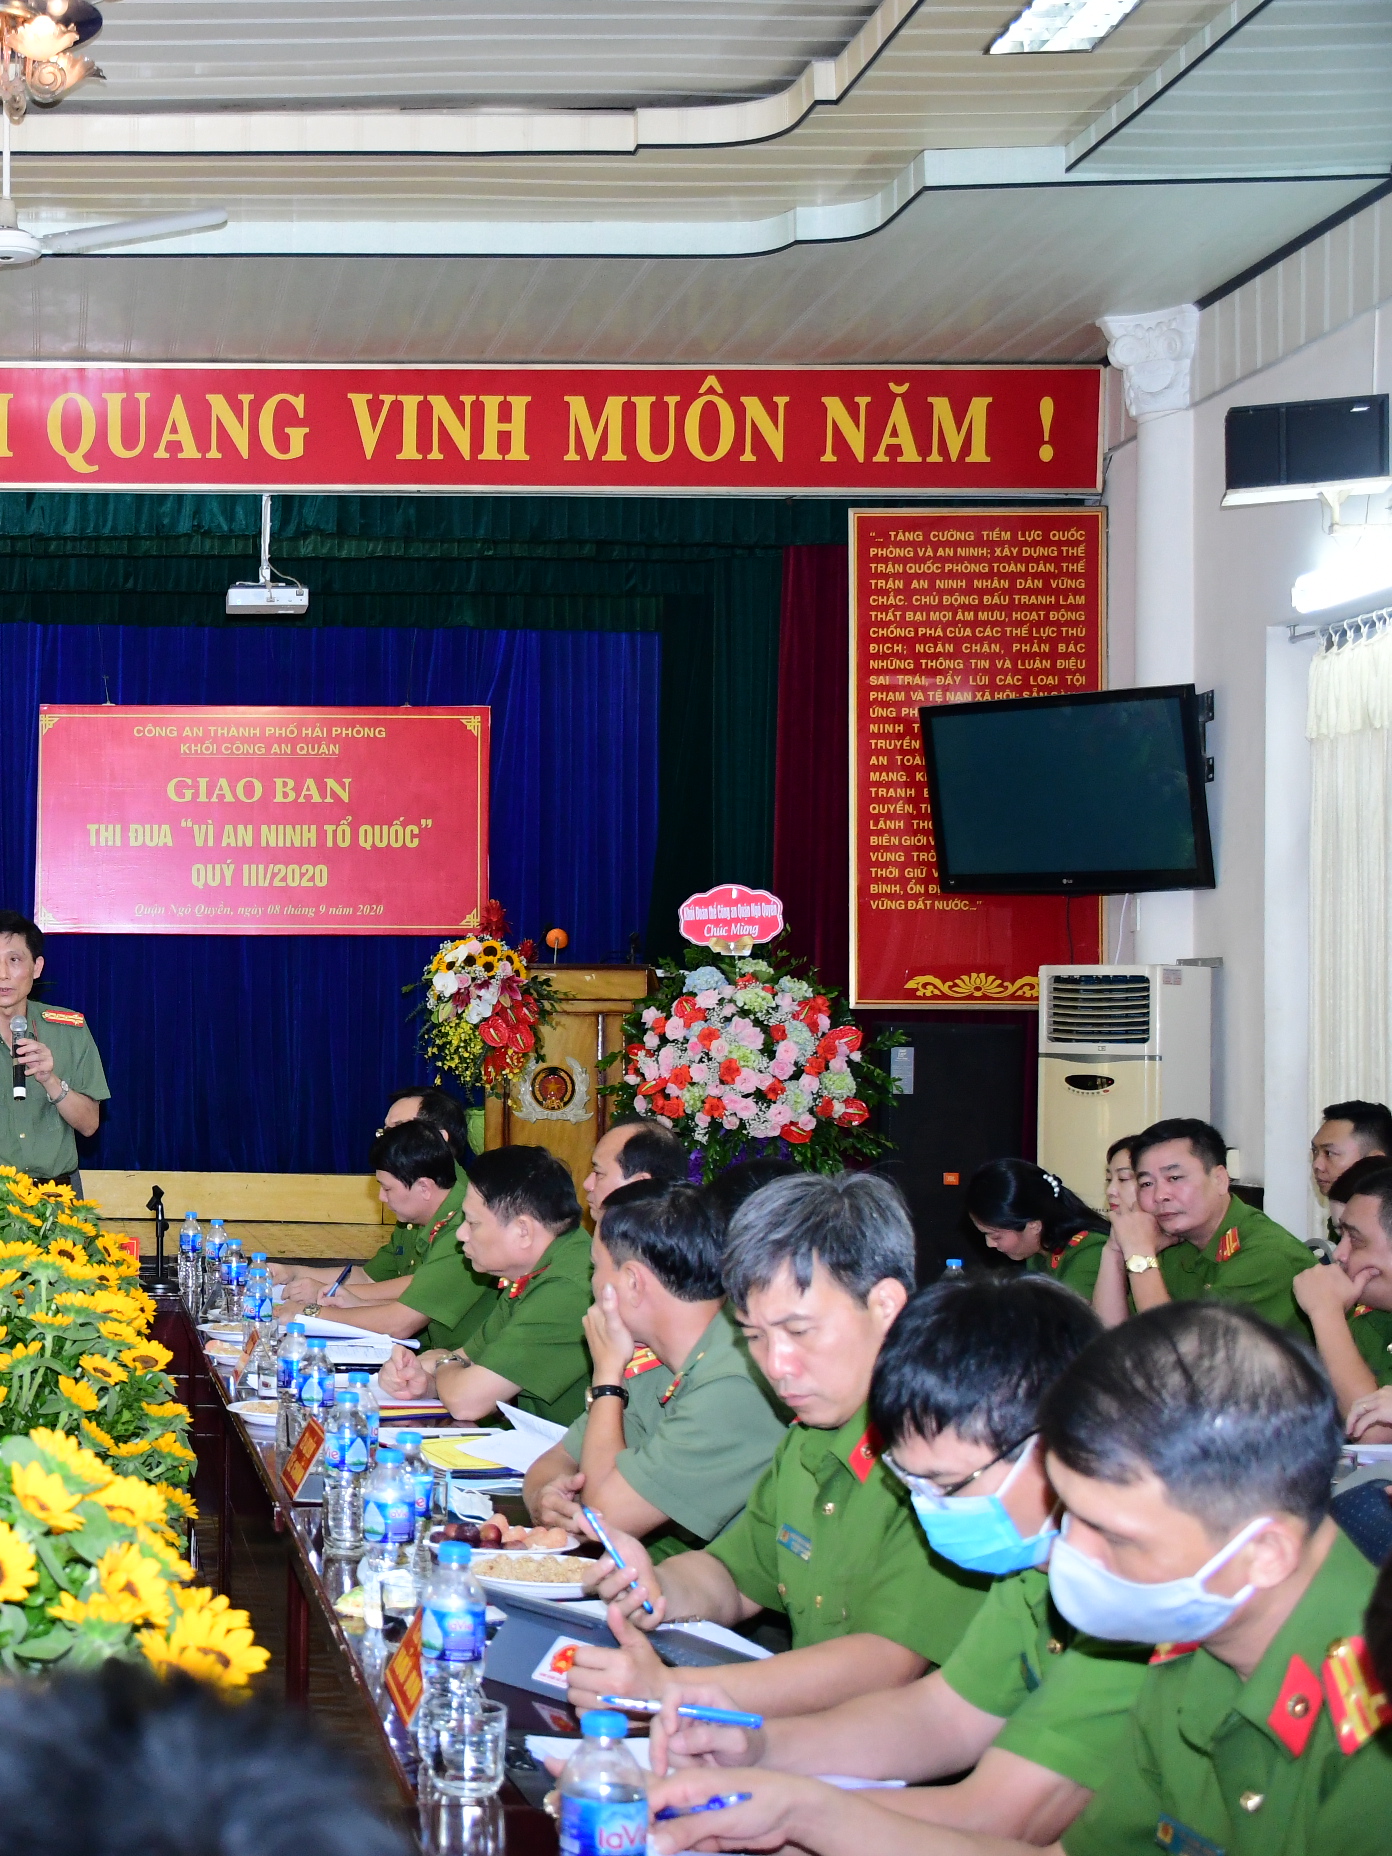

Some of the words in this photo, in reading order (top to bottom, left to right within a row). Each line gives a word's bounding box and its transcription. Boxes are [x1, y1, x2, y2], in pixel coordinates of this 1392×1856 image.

[46, 392, 309, 473] QUANG
[348, 393, 531, 461] VINH
[564, 375, 789, 462] MUÔN
[820, 383, 992, 462] NĂM
[889, 530, 923, 541] TĂNG
[930, 529, 975, 541] CƯỜNG
[1018, 531, 1042, 543] LỰC
[1049, 527, 1086, 542] QUỐC
[870, 545, 913, 558] PHÒNG
[917, 545, 933, 557] VÀ
[937, 547, 953, 557] AN
[957, 547, 991, 558] NINH;
[994, 545, 1018, 557] XÂY
[1022, 547, 1057, 559] DỰNG
[1061, 543, 1086, 557] THẾ
[870, 562, 903, 574] TRẬN
[906, 560, 941, 574] QUỐC
[945, 562, 988, 573] PHÒNG
[992, 561, 1026, 573] TOÀN
[1061, 560, 1086, 573] THẾ
[870, 578, 903, 591] TRẬN
[911, 580, 928, 589] AN
[936, 580, 965, 589] NINH
[974, 578, 1009, 589] NHÂN
[1016, 578, 1042, 589] DÂN
[1050, 578, 1085, 589] VỮNG
[913, 592, 939, 605] CHỦ
[942, 593, 978, 607] ĐỘNG
[983, 591, 1009, 605] ĐẤU
[1013, 596, 1055, 605] TRANH
[1060, 593, 1085, 605] LÀM
[870, 608, 902, 622] THẤT
[906, 612, 926, 623] BẠI
[930, 612, 952, 623] MỌI
[956, 609, 975, 621] ÂM
[1012, 612, 1046, 623] HOẠT
[1049, 609, 1085, 623] ĐỘNG
[870, 624, 915, 638] CHỐNG
[918, 626, 942, 637] PHÁ
[947, 624, 972, 637] CỦA
[976, 626, 1001, 637] CÁC
[1006, 624, 1029, 637] THẾ
[1033, 626, 1057, 639] LỰC
[1061, 626, 1086, 637] THÙ
[915, 642, 953, 653] NGĂN
[1058, 642, 1086, 653] BÁC
[870, 657, 914, 670] NHỮNG
[920, 658, 964, 669] THÔNG
[970, 660, 989, 669] TIN
[996, 657, 1012, 669] VÀ
[1018, 658, 1050, 671] LUẬN
[1056, 658, 1086, 671] ĐIỆU
[870, 676, 890, 686] SAI
[897, 674, 929, 687] TRÁI,
[970, 674, 989, 685] LÙI
[996, 674, 1022, 686] CÁC
[1030, 675, 1058, 687] LOẠI
[1065, 674, 1086, 687] TỘI
[870, 691, 905, 703] PHẠM
[911, 690, 924, 701] VÀ
[928, 690, 942, 703] TỆ
[975, 690, 991, 701] XÃ
[870, 706, 896, 717] ỨNG
[133, 722, 177, 738] CÔNG
[182, 726, 204, 738] AN
[207, 723, 261, 738] THÀNH
[265, 722, 298, 738] PHỐ
[303, 722, 330, 738] HẢI
[332, 724, 386, 738] PHÒNG
[870, 724, 903, 733] NINH
[180, 738, 217, 755] KHỐI
[221, 741, 266, 755] CÔNG
[270, 743, 292, 755] AN
[296, 740, 339, 757] QUẬN
[870, 756, 887, 765] AN
[167, 777, 263, 803] GIAO
[273, 777, 351, 803] BAN
[870, 788, 915, 797] TRANH
[870, 818, 904, 829] LÃNH
[87, 824, 121, 847] THI
[129, 824, 172, 847] ĐUA
[222, 825, 253, 847] AN
[261, 825, 316, 847] NINH
[324, 815, 352, 848] TỔ
[870, 834, 898, 845] BIÊN
[902, 834, 926, 845] GIỚI
[870, 850, 904, 861] VÙNG
[191, 859, 233, 887] QUÝ
[242, 864, 328, 887] III/2020
[870, 866, 898, 877] THỜI
[870, 898, 905, 910] VỮNG
[908, 897, 932, 910] ĐẤT
[133, 903, 165, 918] Quận
[168, 904, 191, 917] Ngô
[237, 904, 265, 918] ngày
[267, 904, 281, 916] 08
[282, 904, 315, 917] tháng
[319, 904, 325, 916] 9
[328, 904, 354, 916] năm
[357, 904, 384, 916] 2020
[704, 924, 728, 937] Chúc
